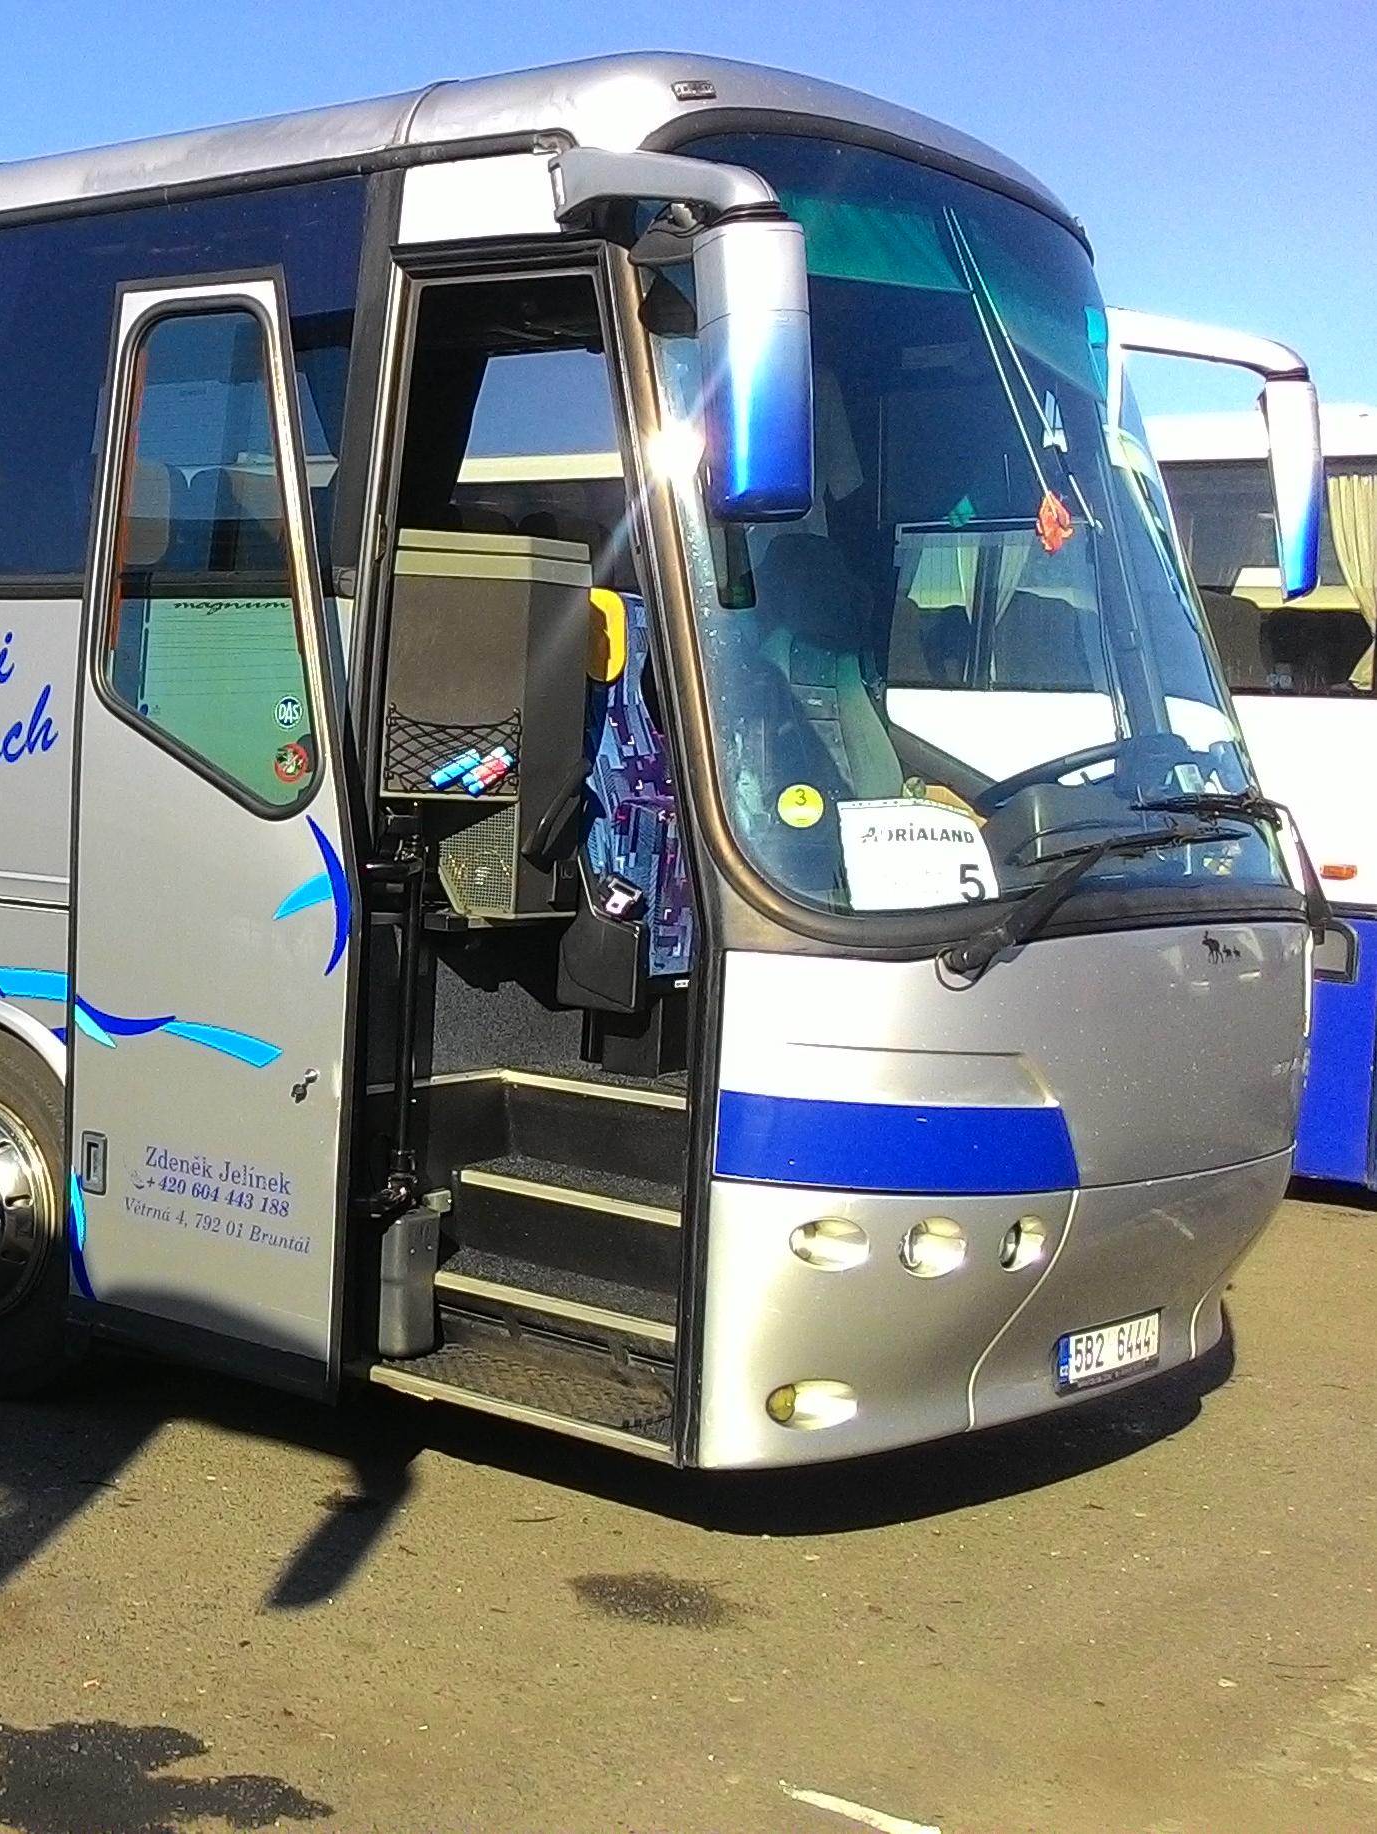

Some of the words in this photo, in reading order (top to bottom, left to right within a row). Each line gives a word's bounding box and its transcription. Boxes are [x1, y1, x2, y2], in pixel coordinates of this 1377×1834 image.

[174, 600, 289, 615] magnum
[795, 788, 807, 806] 3
[959, 864, 986, 902] 5
[145, 1145, 213, 1180] Zdeněk
[191, 1183, 219, 1202] 604
[225, 1189, 253, 1210] 443
[260, 1196, 290, 1218] 188
[195, 1213, 220, 1233] 792
[1074, 1333, 1105, 1373] 5B2
[1117, 1319, 1151, 1361] 6444
